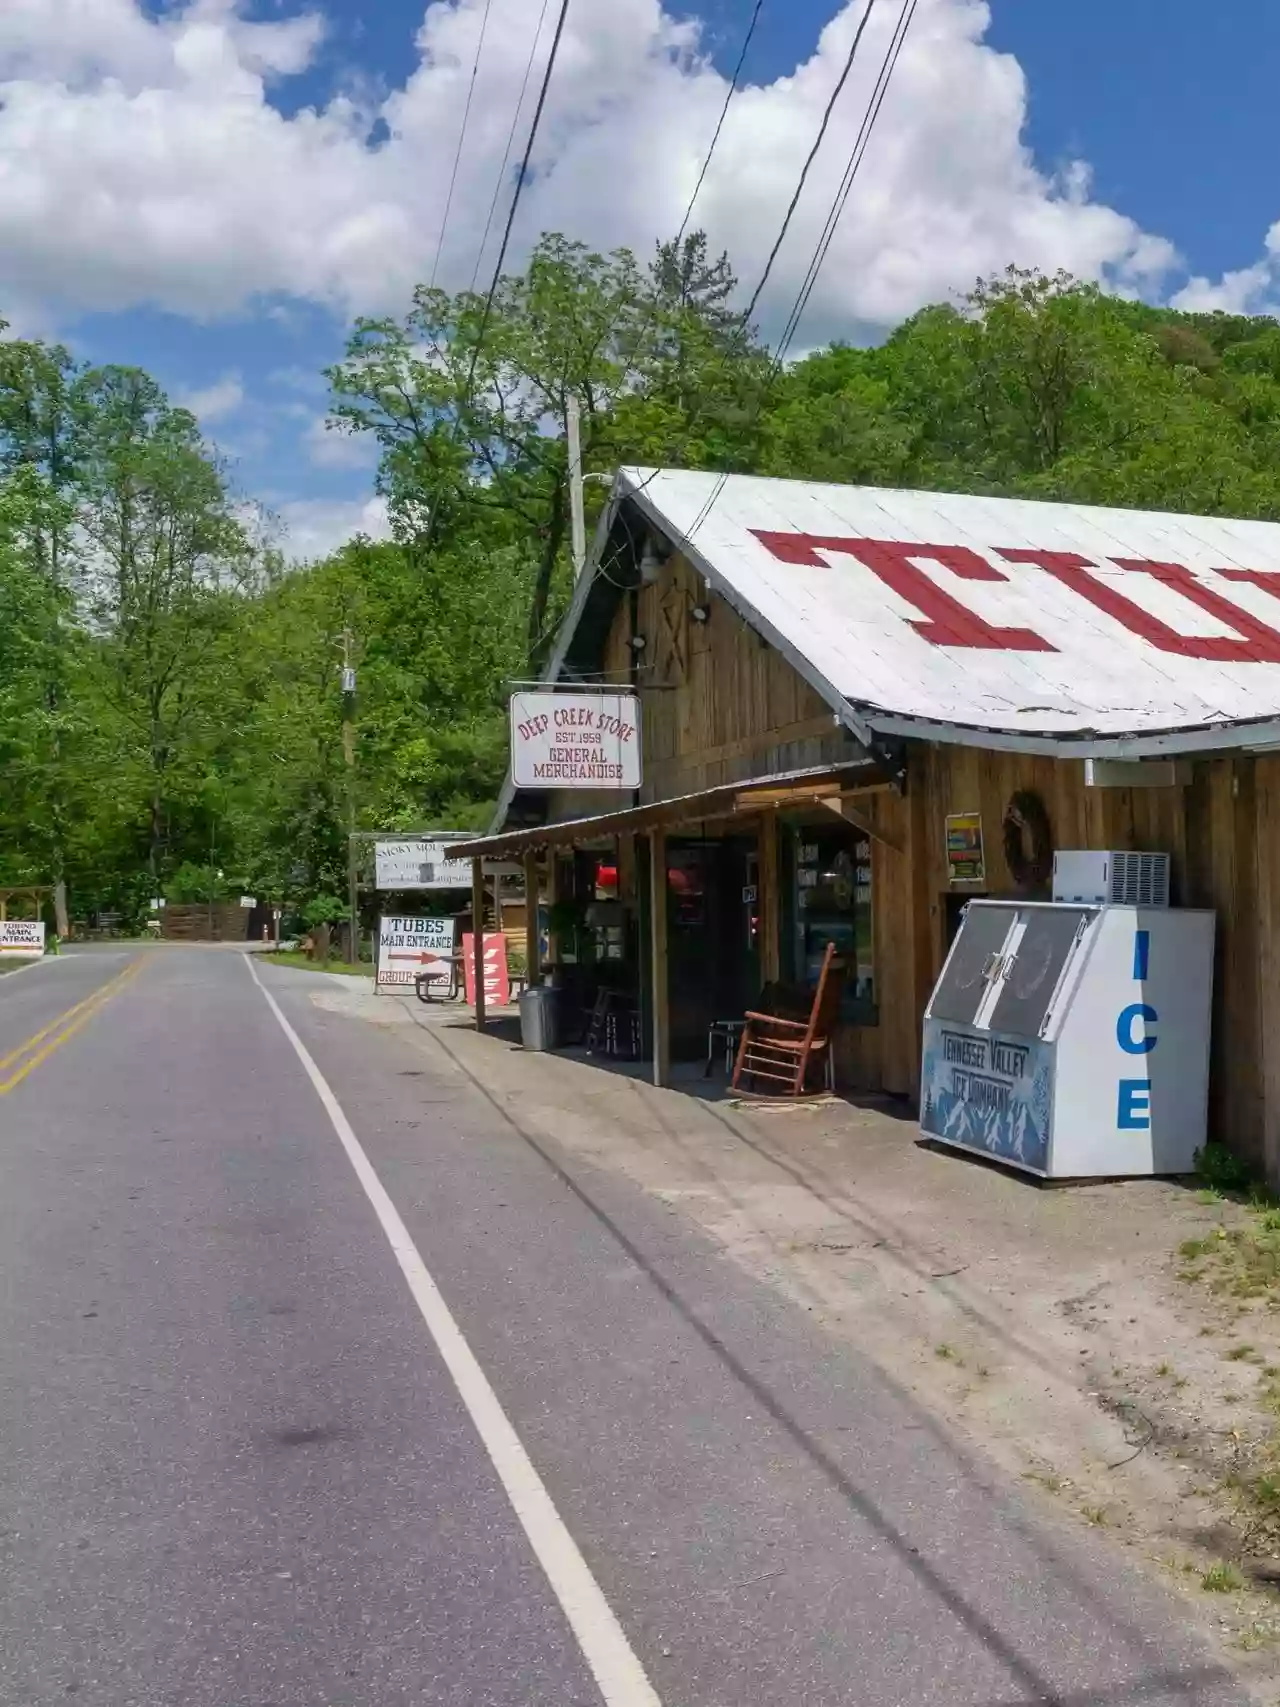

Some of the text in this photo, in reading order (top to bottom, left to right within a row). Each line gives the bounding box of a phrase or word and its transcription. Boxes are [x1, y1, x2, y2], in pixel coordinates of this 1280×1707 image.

[517, 708, 636, 742] DEEP CREEK STORE
[549, 747, 607, 763] GENERAL
[533, 764, 624, 779] MERCHANDISE
[391, 918, 445, 933] TUBES
[380, 934, 453, 949] MAIN ENTRANCE
[379, 970, 413, 983] GROUP
[1116, 930, 1158, 1129] ICE
[941, 1029, 1030, 1079] TENNESSEE VALLEY
